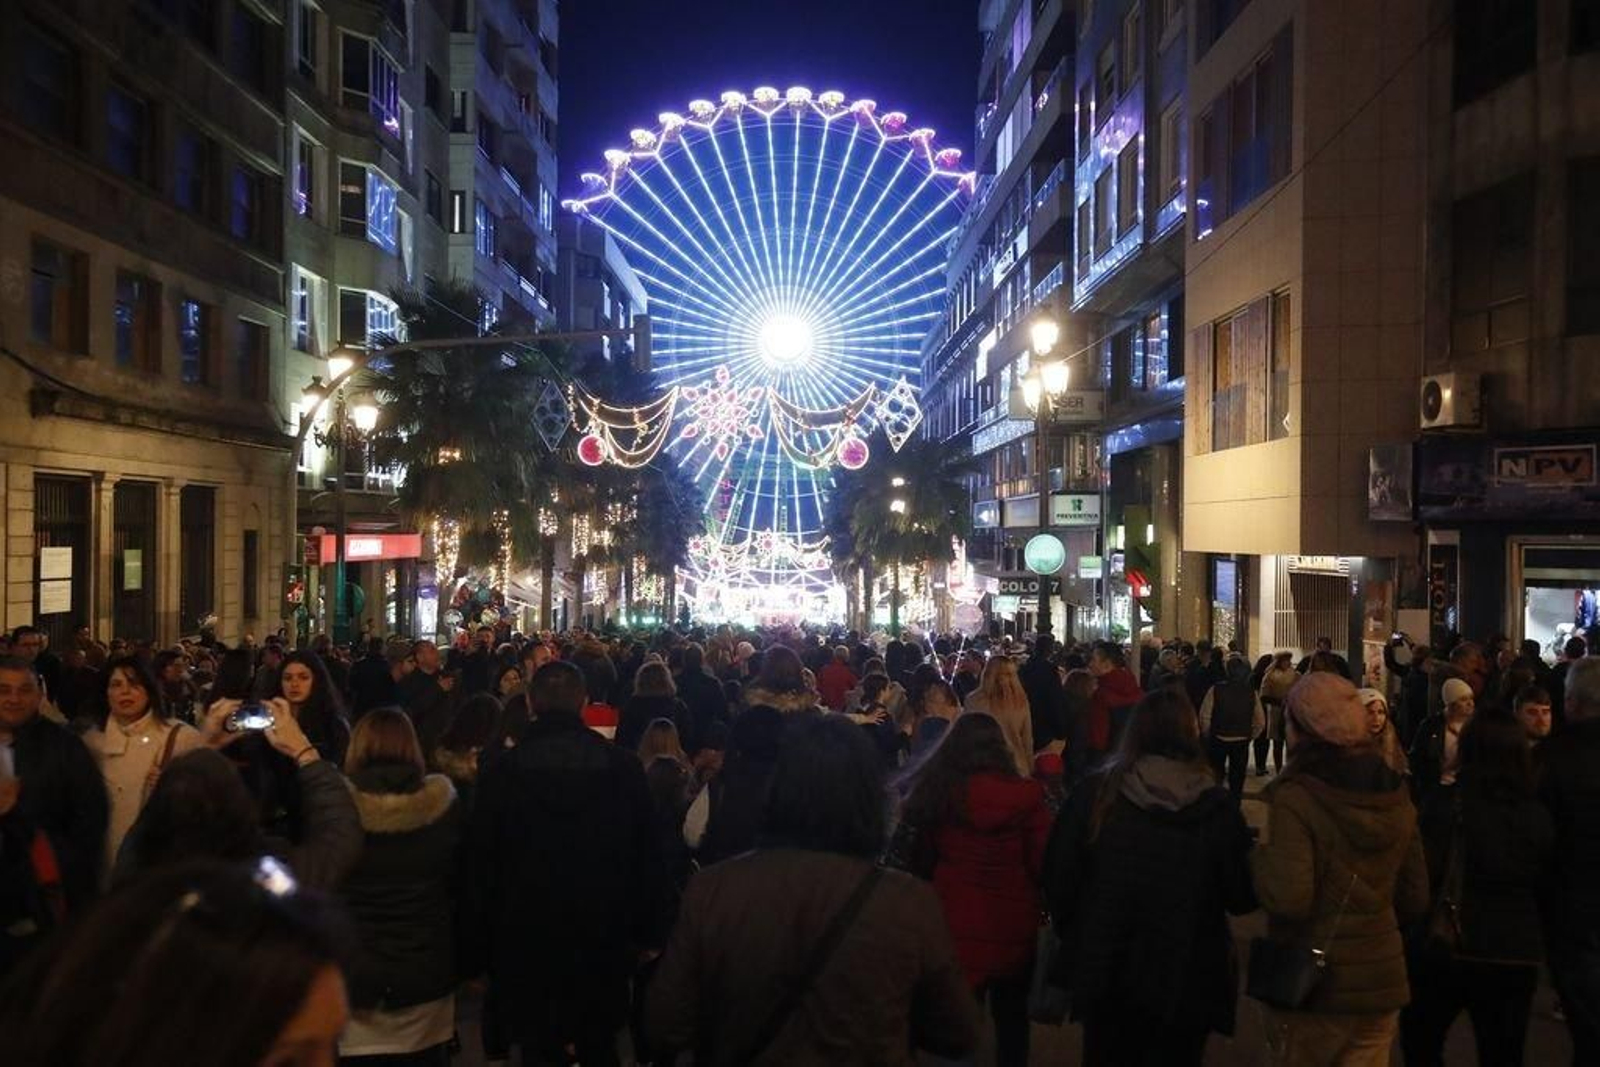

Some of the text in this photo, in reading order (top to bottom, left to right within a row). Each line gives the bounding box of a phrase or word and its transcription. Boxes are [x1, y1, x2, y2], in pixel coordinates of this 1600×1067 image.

[1502, 457, 1582, 477] NPV
[1000, 581, 1059, 594] COLO 7
